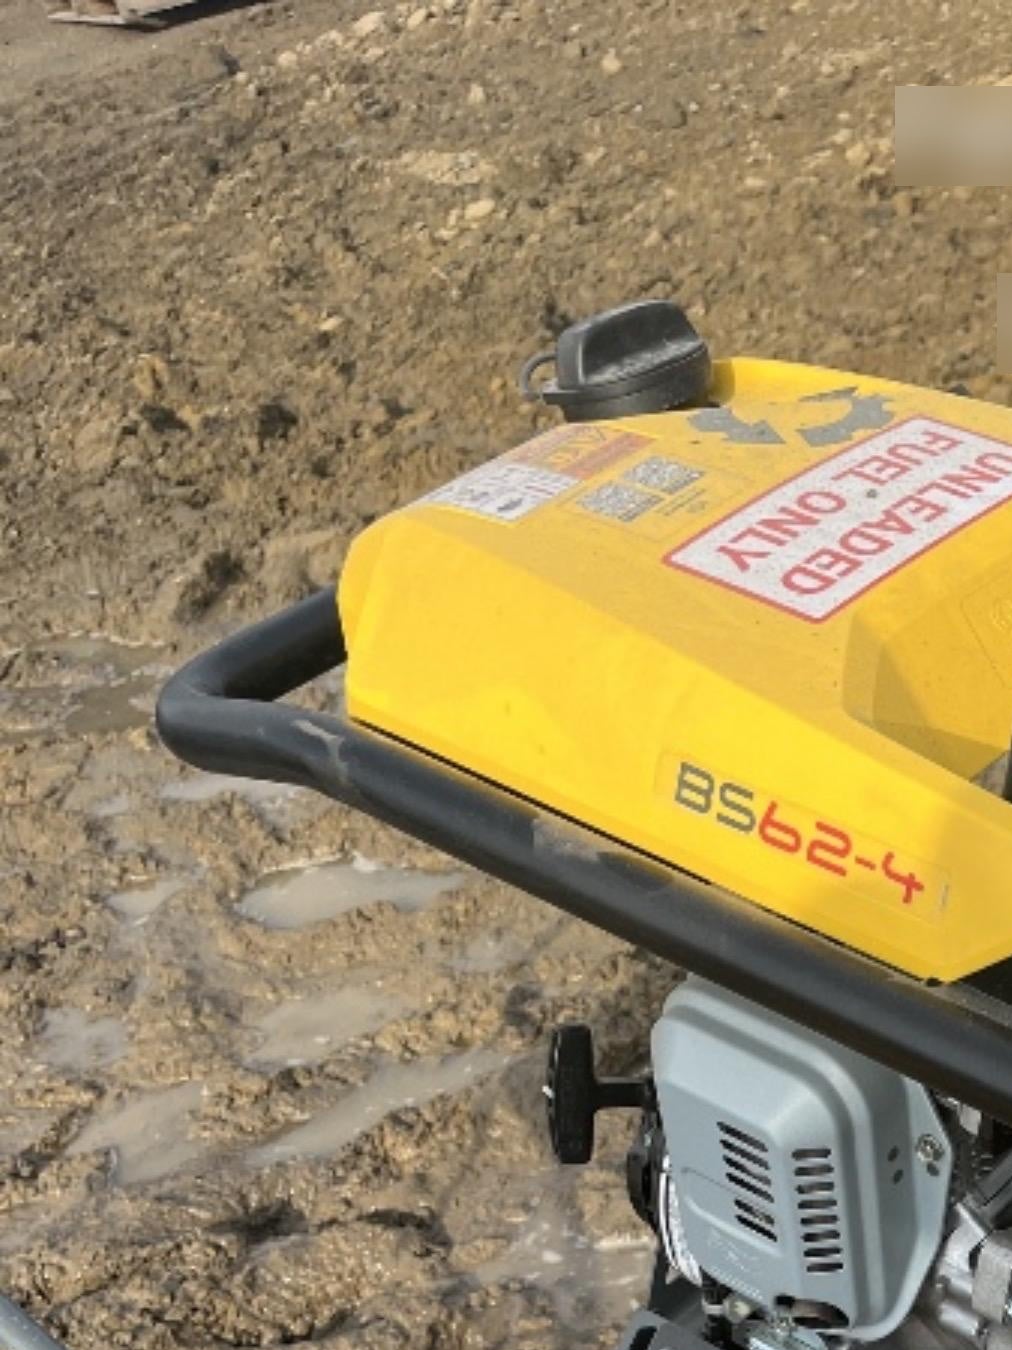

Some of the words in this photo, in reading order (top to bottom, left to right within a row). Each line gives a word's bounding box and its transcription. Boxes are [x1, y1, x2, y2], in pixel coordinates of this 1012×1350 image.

[830, 430, 963, 487] FUEL
[715, 489, 848, 573] ONLY
[674, 760, 925, 904] BS62-4
